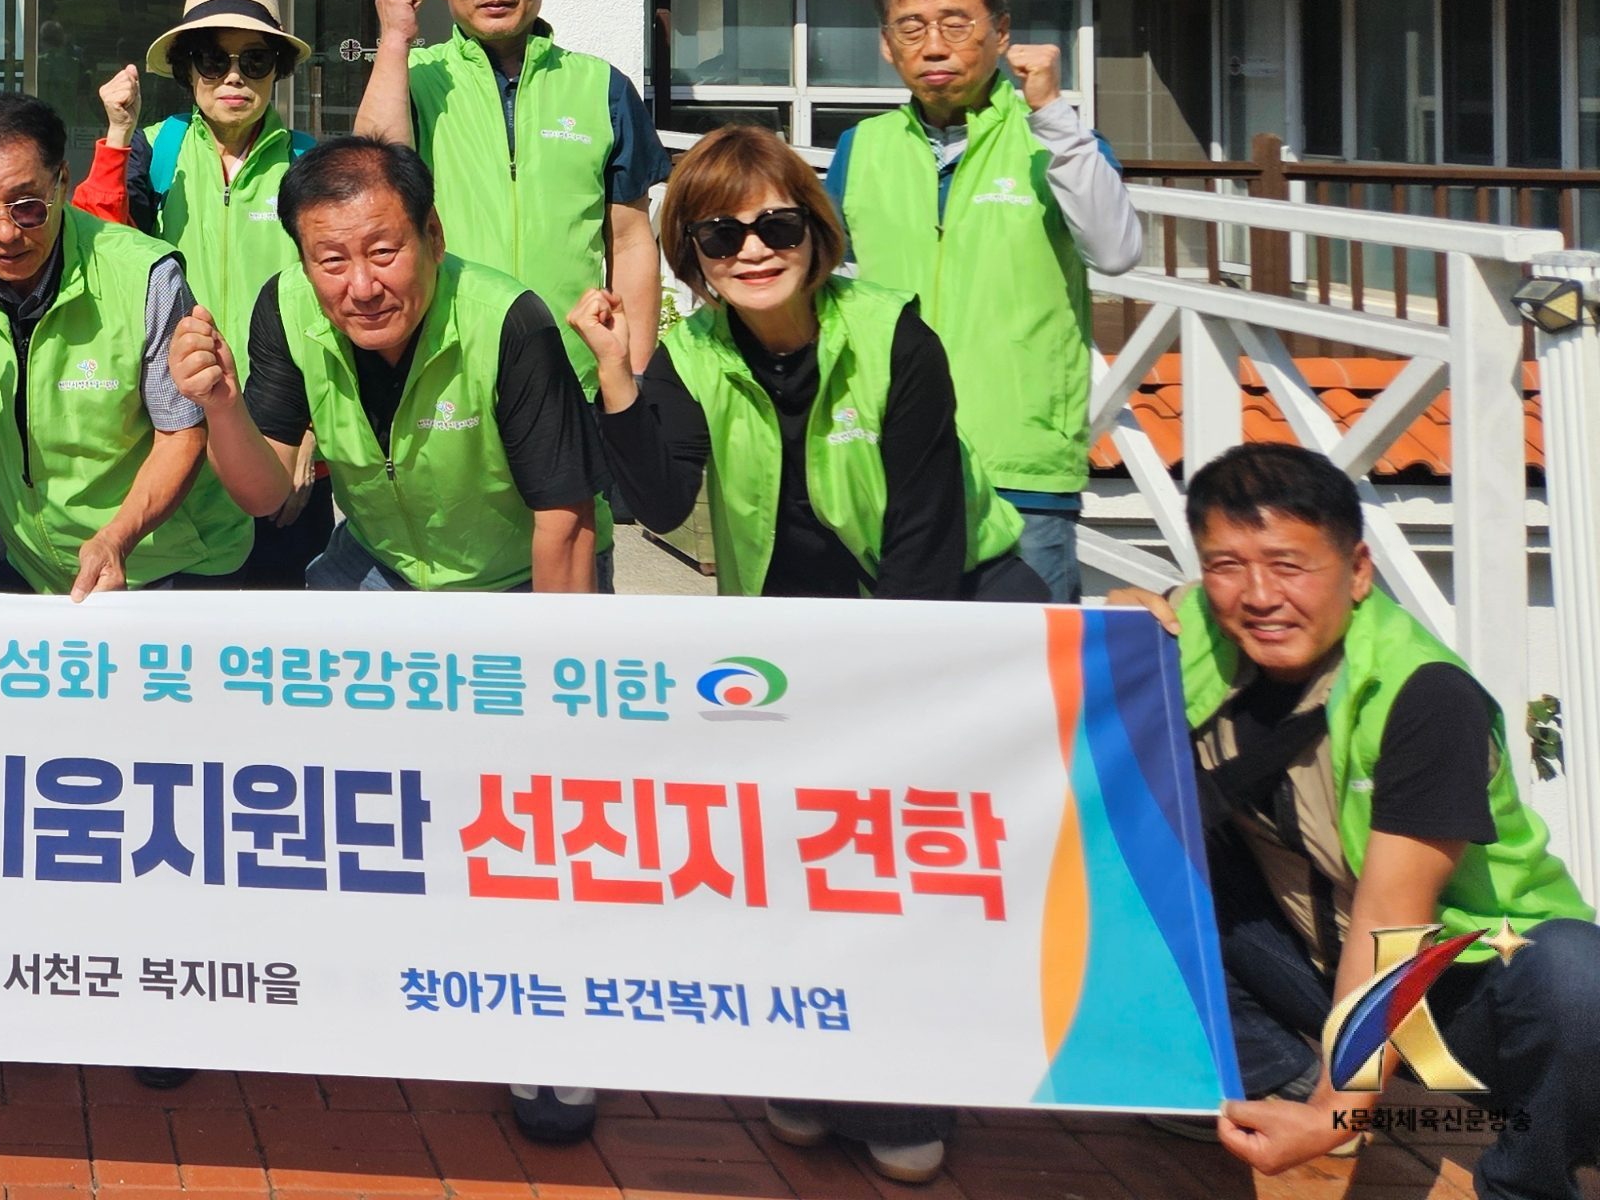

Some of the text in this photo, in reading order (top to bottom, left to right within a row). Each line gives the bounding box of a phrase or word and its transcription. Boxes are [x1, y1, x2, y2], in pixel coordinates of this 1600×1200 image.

[139, 641, 192, 702] 및
[219, 645, 526, 715] 역량강화를
[552, 657, 676, 720] 위한
[459, 773, 768, 907] 선진지
[795, 787, 1007, 921] 견학
[4, 953, 122, 997] 서천군
[139, 958, 300, 1005] 복지마을
[400, 968, 851, 1032] 찾아가는 보건복지 사업
